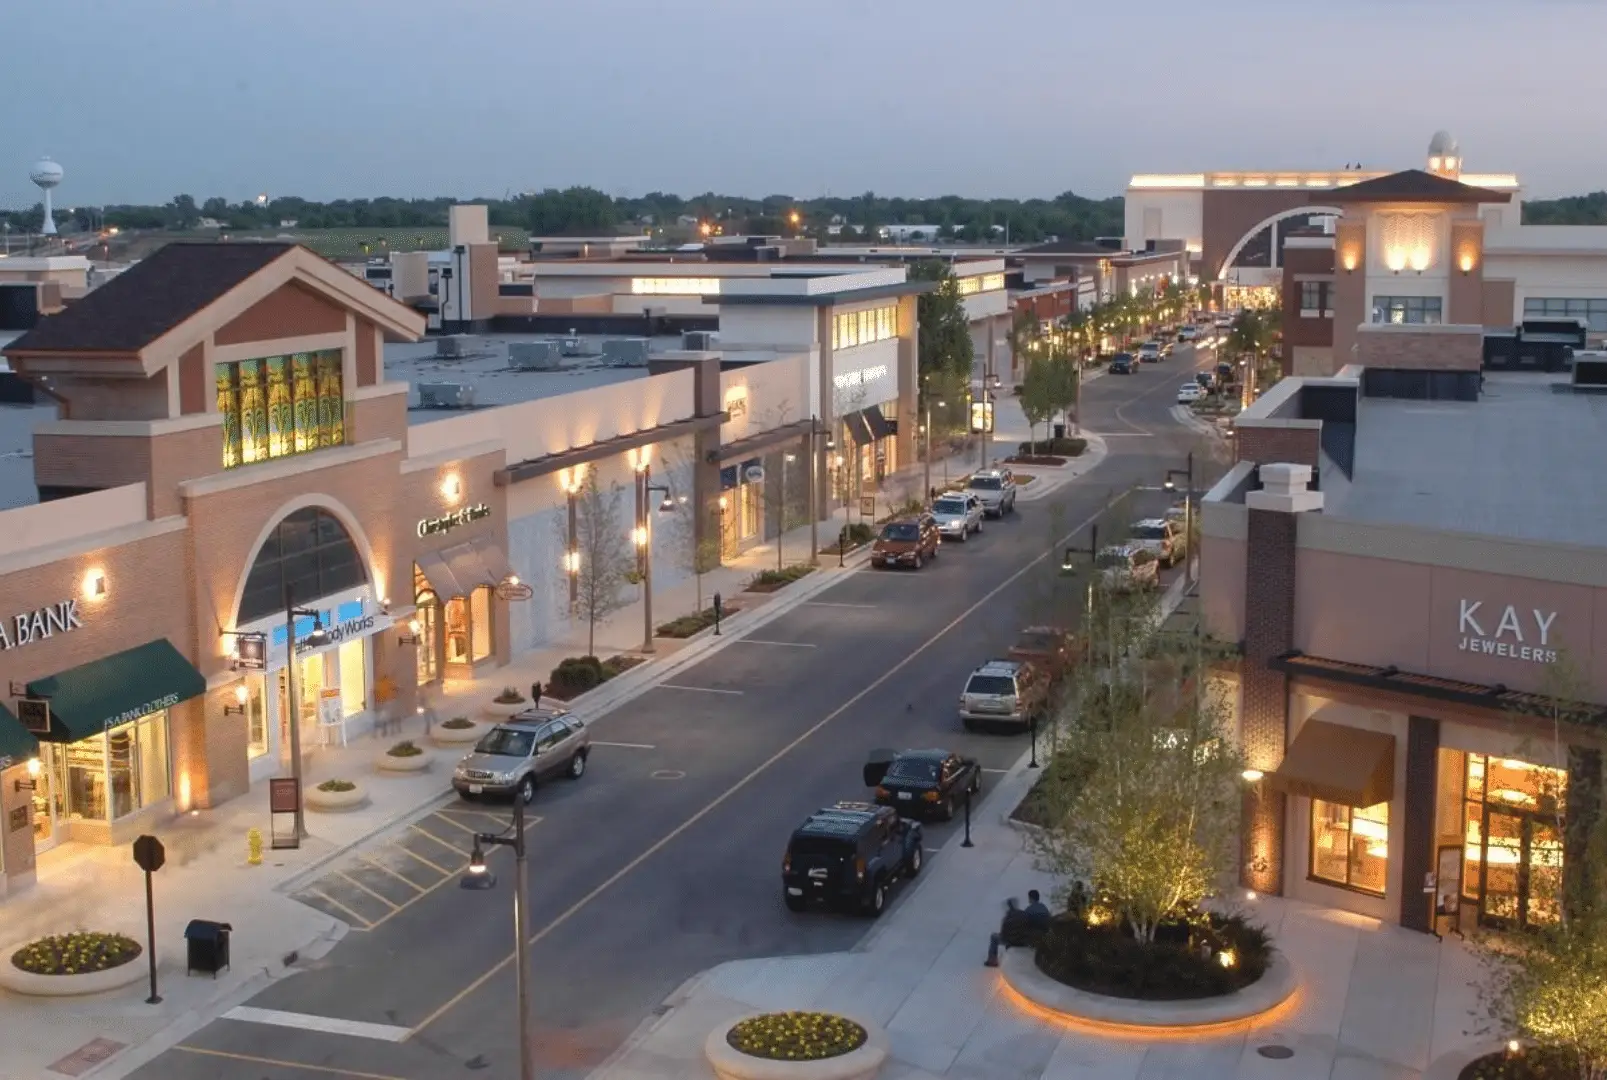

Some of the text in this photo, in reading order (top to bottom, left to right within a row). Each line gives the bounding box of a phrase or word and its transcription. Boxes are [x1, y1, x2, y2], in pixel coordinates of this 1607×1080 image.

[16, 598, 83, 646] BANK
[345, 615, 374, 636] Works
[1459, 599, 1558, 646] KAY
[1458, 636, 1557, 663] JEWELERS
